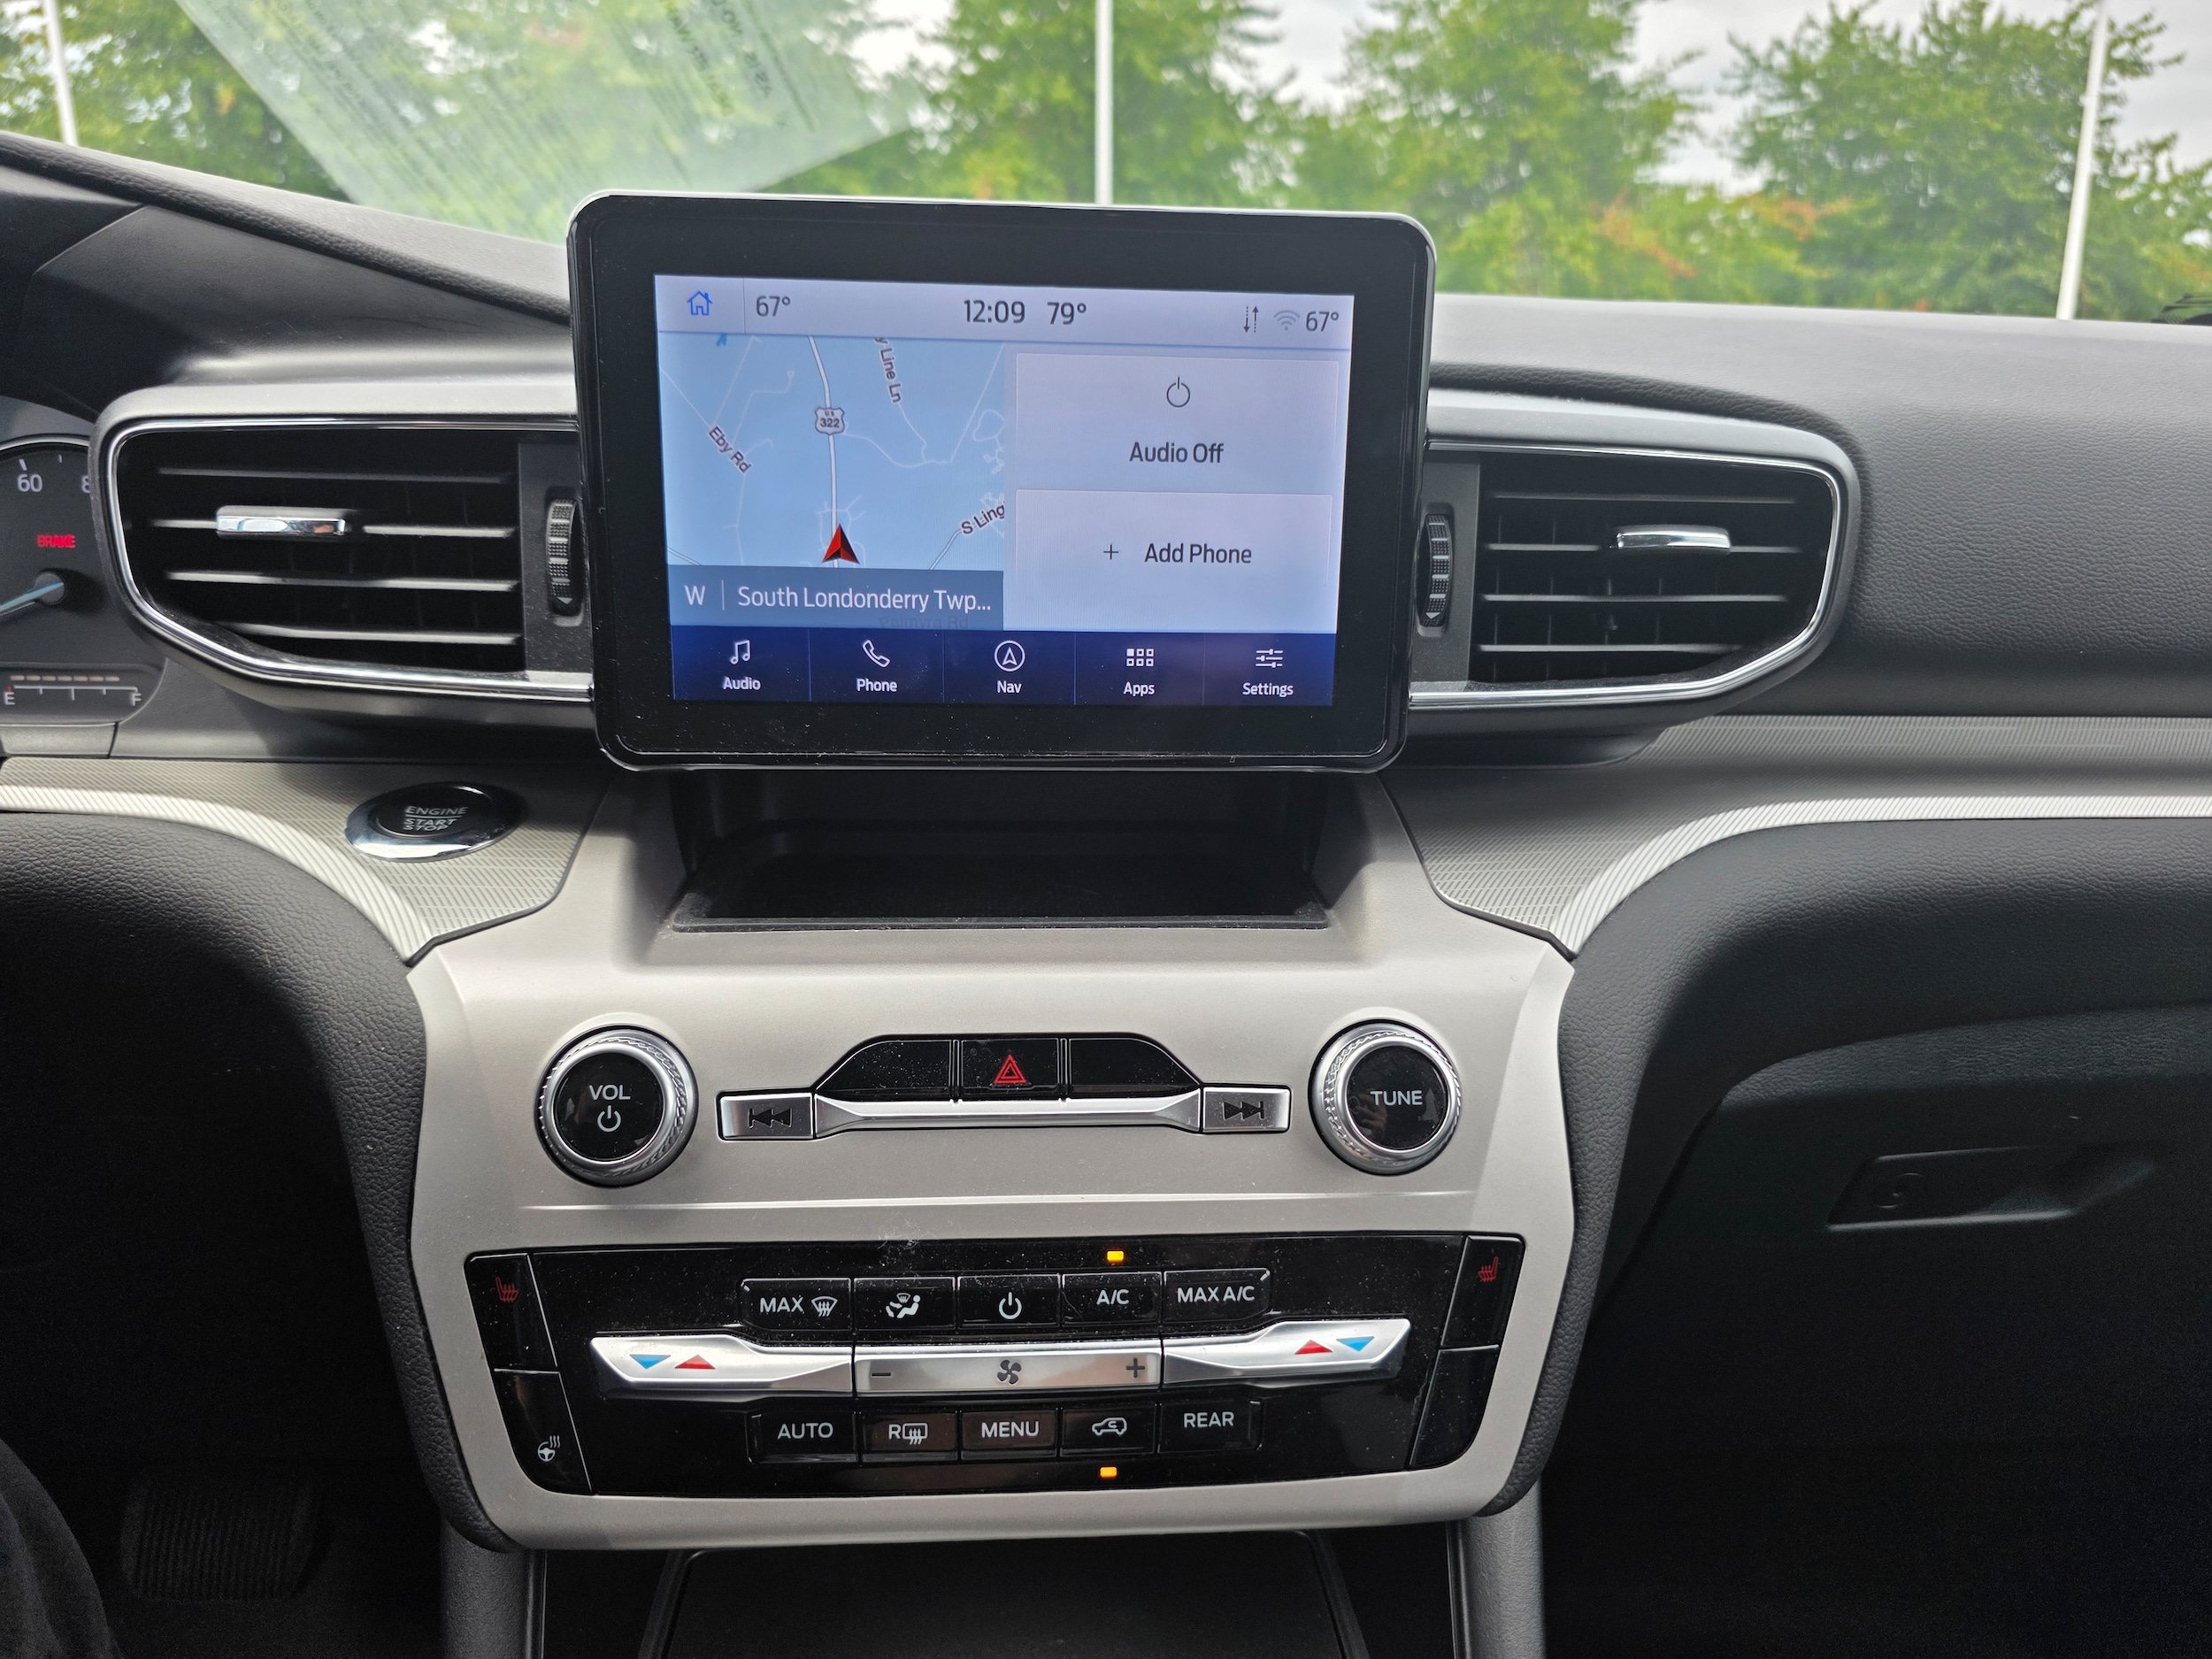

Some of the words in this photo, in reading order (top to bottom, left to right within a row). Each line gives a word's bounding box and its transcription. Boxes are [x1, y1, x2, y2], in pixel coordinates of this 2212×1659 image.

[756, 296, 791, 318] 67°
[963, 299, 1026, 324] 12:09
[1047, 302, 1087, 326] 79°
[1305, 311, 1340, 333] 67°
[880, 348, 895, 380] Line
[888, 383, 902, 403] Ln
[819, 418, 840, 429] 322
[708, 426, 733, 456] Eby
[730, 451, 751, 473] Rd
[1129, 442, 1188, 463] Audio
[1192, 443, 1224, 464] Off
[18, 473, 43, 493] 60
[961, 520, 973, 534] S
[973, 501, 1005, 528] Ling
[37, 534, 76, 548] BRAKE
[1144, 542, 1184, 564] Add
[1189, 543, 1252, 565] Phone
[684, 585, 706, 605] W
[737, 586, 798, 608] South
[803, 588, 929, 613] Londonderry
[933, 589, 991, 614] Twp...
[723, 676, 761, 691] Audio
[856, 678, 897, 692] Phone
[996, 680, 1022, 695] Nav
[1123, 681, 1155, 696] Apps
[1242, 682, 1294, 697] Settings
[4, 692, 15, 705] E
[132, 693, 142, 706] F
[403, 806, 469, 816] ENGINE
[589, 1084, 631, 1101] VOL
[1371, 1089, 1423, 1106] TUNE
[1096, 1289, 1130, 1305] A/C
[1177, 1286, 1219, 1302] MAX
[1223, 1286, 1256, 1302] A/C
[759, 1297, 804, 1313] MAX
[1183, 1411, 1234, 1429] REAR
[777, 1422, 833, 1440] AUTO
[980, 1421, 1039, 1438] MENU
